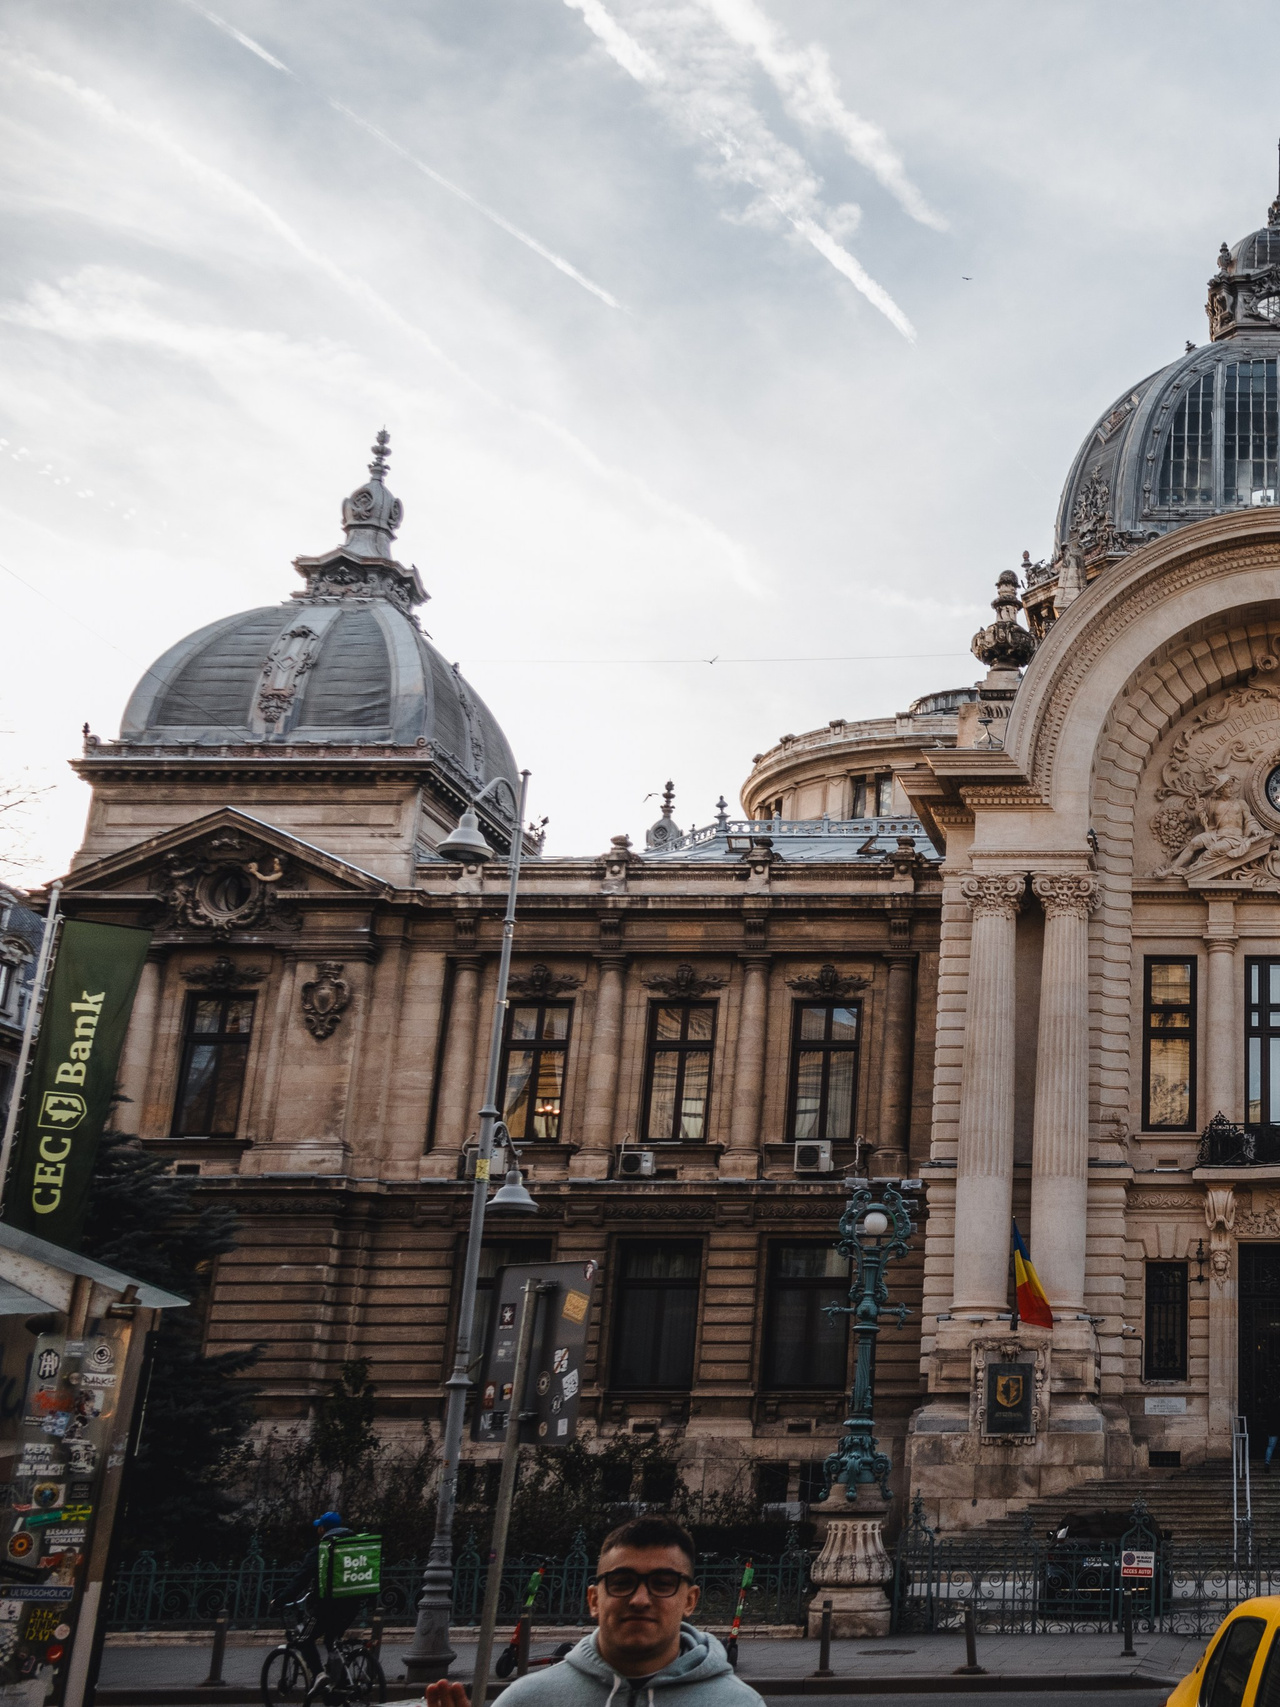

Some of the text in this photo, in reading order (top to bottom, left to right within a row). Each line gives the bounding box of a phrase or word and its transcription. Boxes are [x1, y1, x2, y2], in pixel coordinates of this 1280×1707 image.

[32, 990, 106, 1214] CEC Bank
[343, 1554, 367, 1569] Bolt
[343, 1568, 373, 1583] Food
